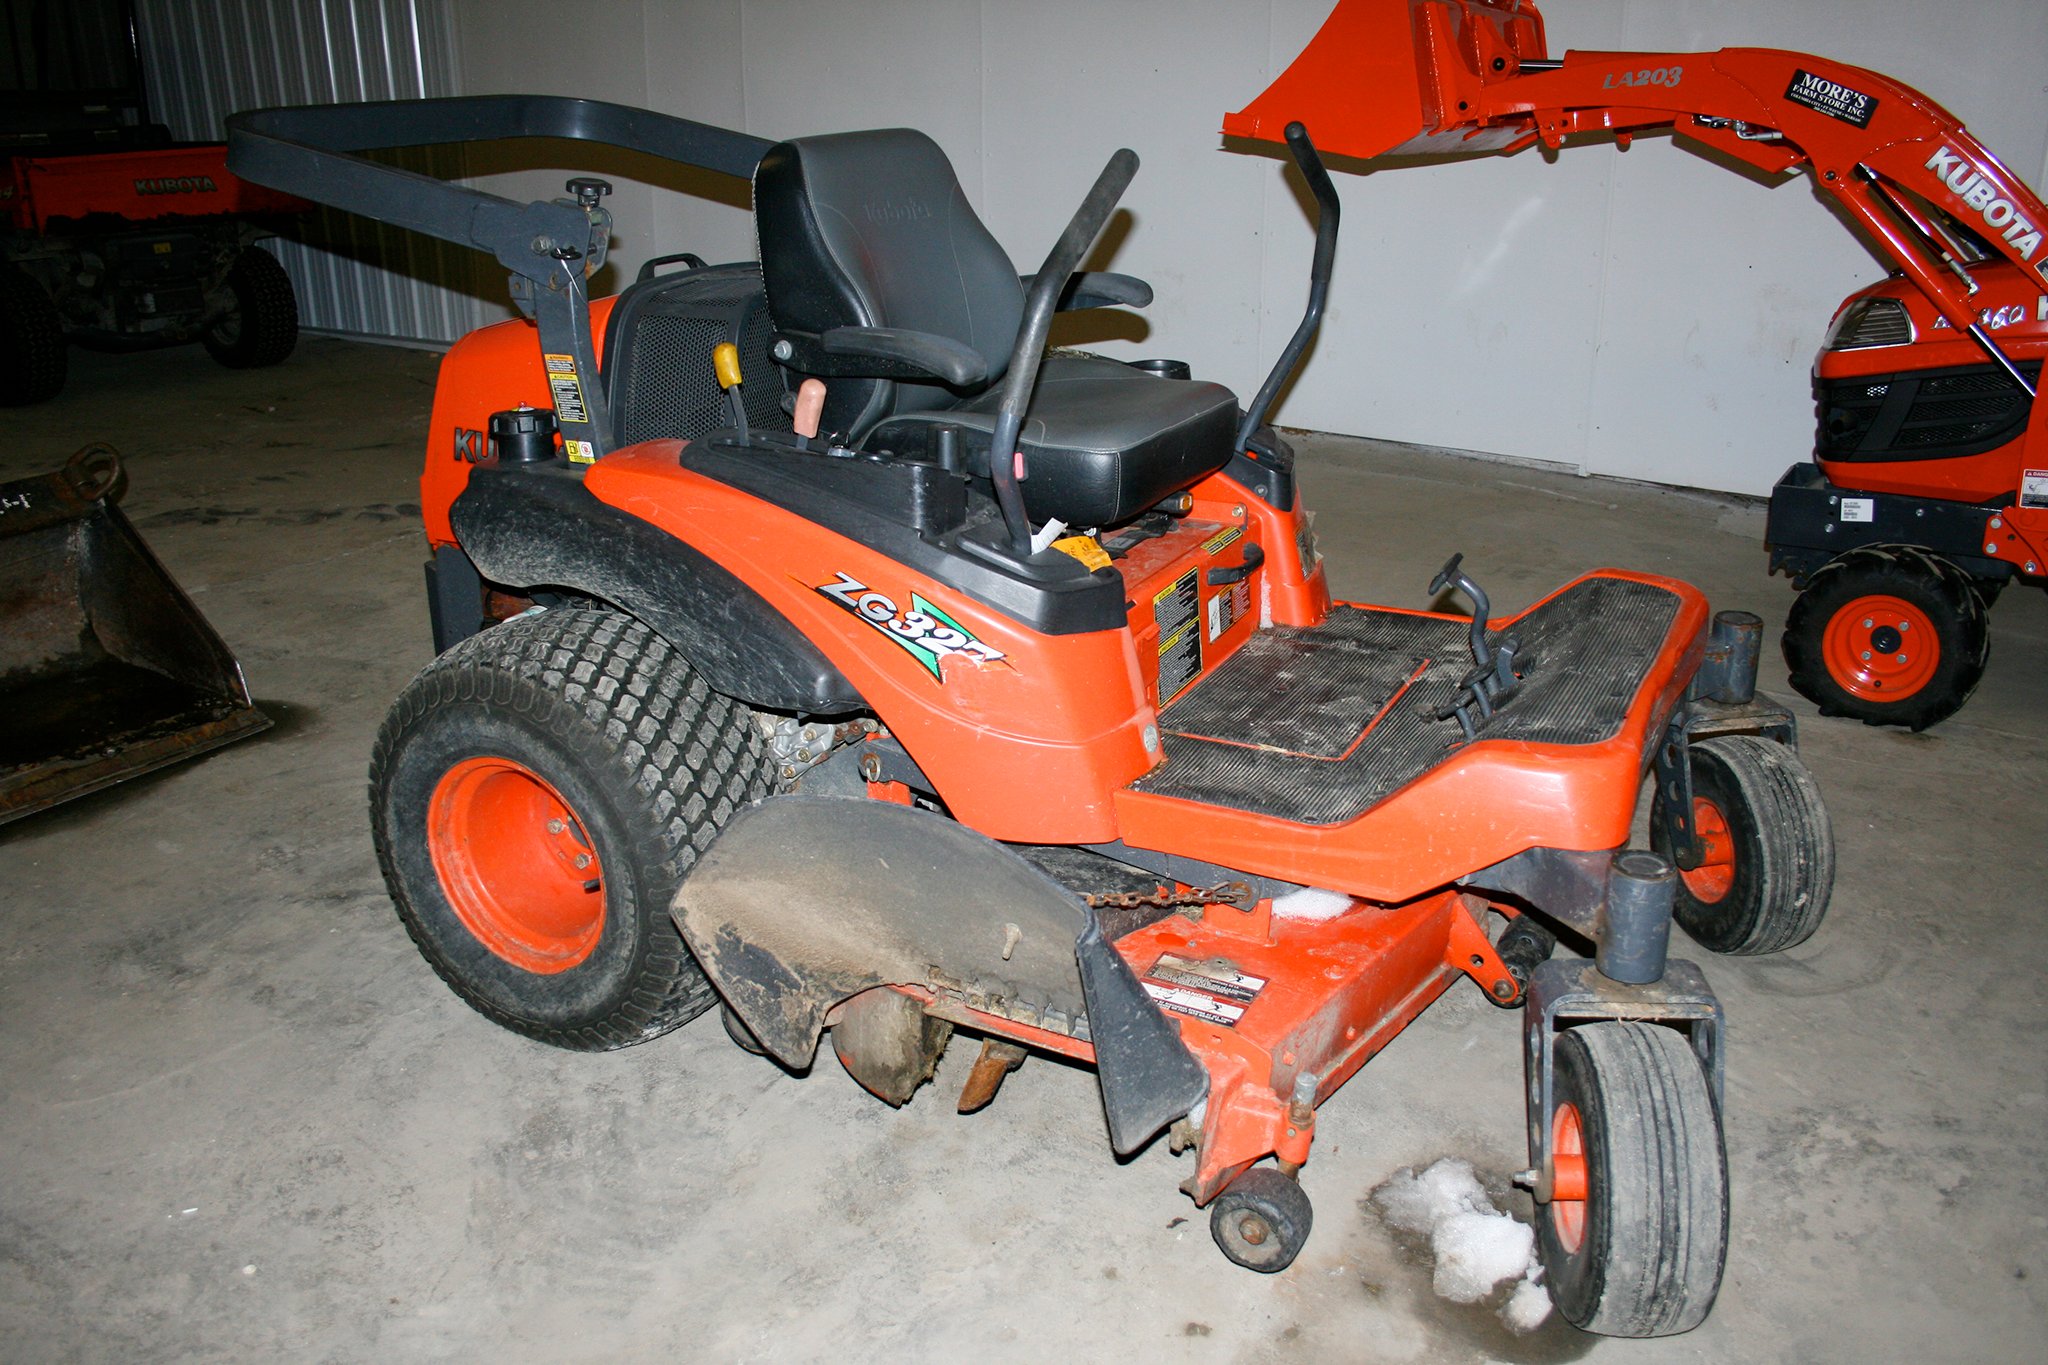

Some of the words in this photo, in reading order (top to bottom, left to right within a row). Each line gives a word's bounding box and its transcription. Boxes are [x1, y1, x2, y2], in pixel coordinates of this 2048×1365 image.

[1602, 66, 1684, 90] LA203
[1800, 73, 1868, 109] MORE'S
[1792, 84, 1818, 100] FARM
[1817, 94, 1847, 111] STORE
[1847, 105, 1865, 118] INC.
[135, 176, 218, 196] KUBOTA
[1924, 146, 2043, 261] KUBOTA
[815, 571, 1007, 664] ZG327
